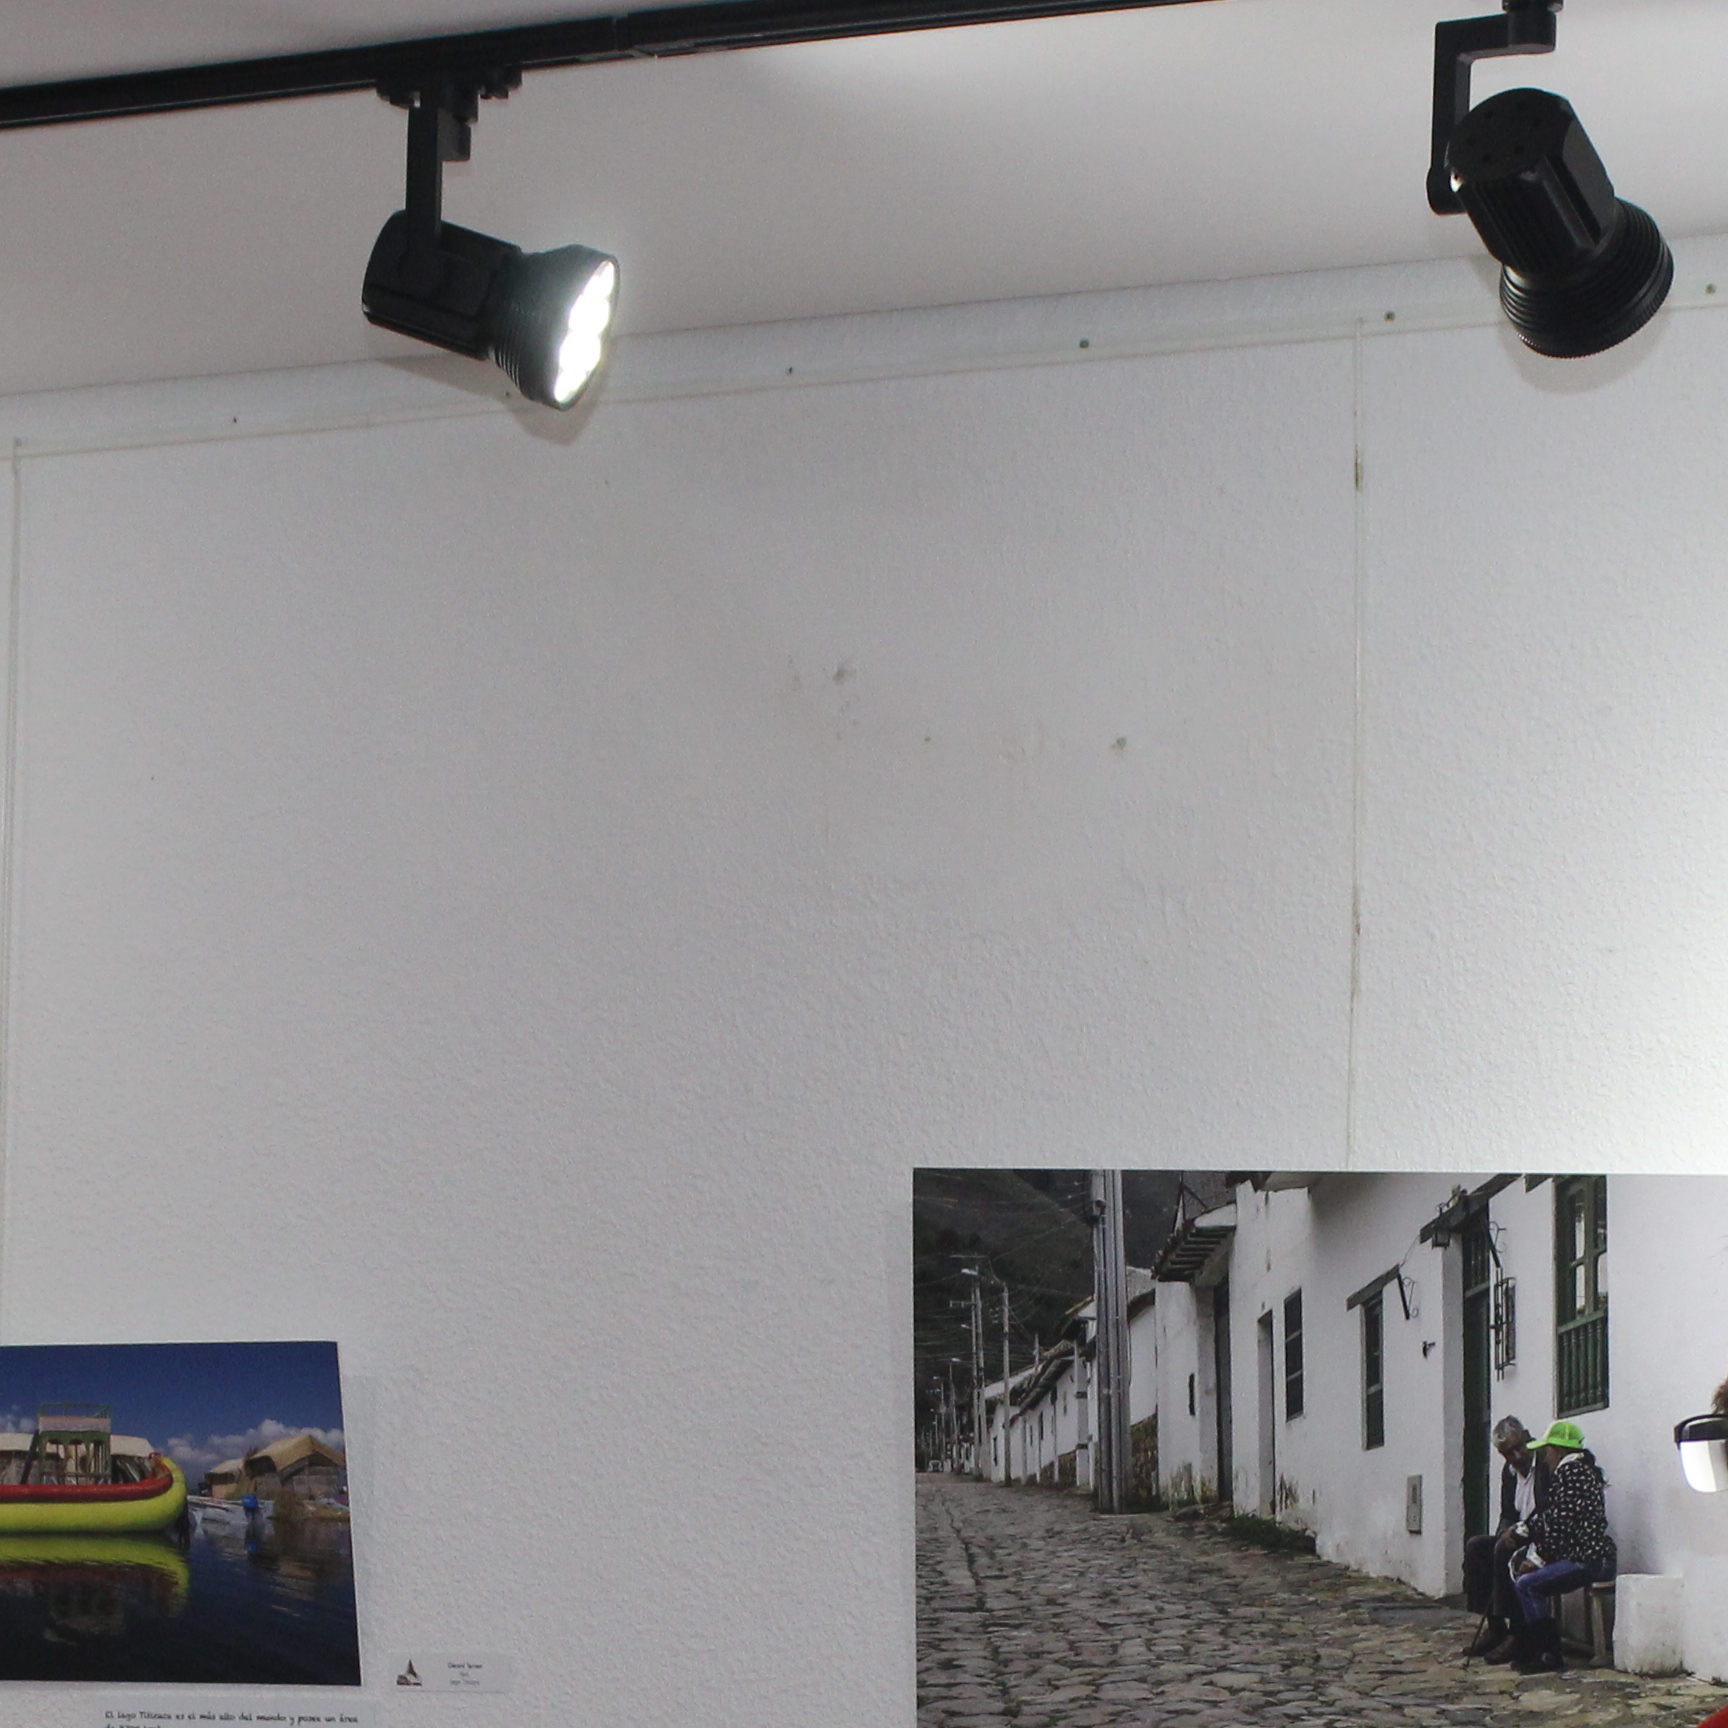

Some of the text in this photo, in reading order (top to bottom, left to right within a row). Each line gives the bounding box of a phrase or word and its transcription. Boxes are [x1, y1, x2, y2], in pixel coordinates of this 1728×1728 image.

[238, 1712, 252, 1721] del
[257, 1713, 286, 1721] mundo
[289, 1716, 294, 1725] y
[298, 1715, 320, 1725] posee
